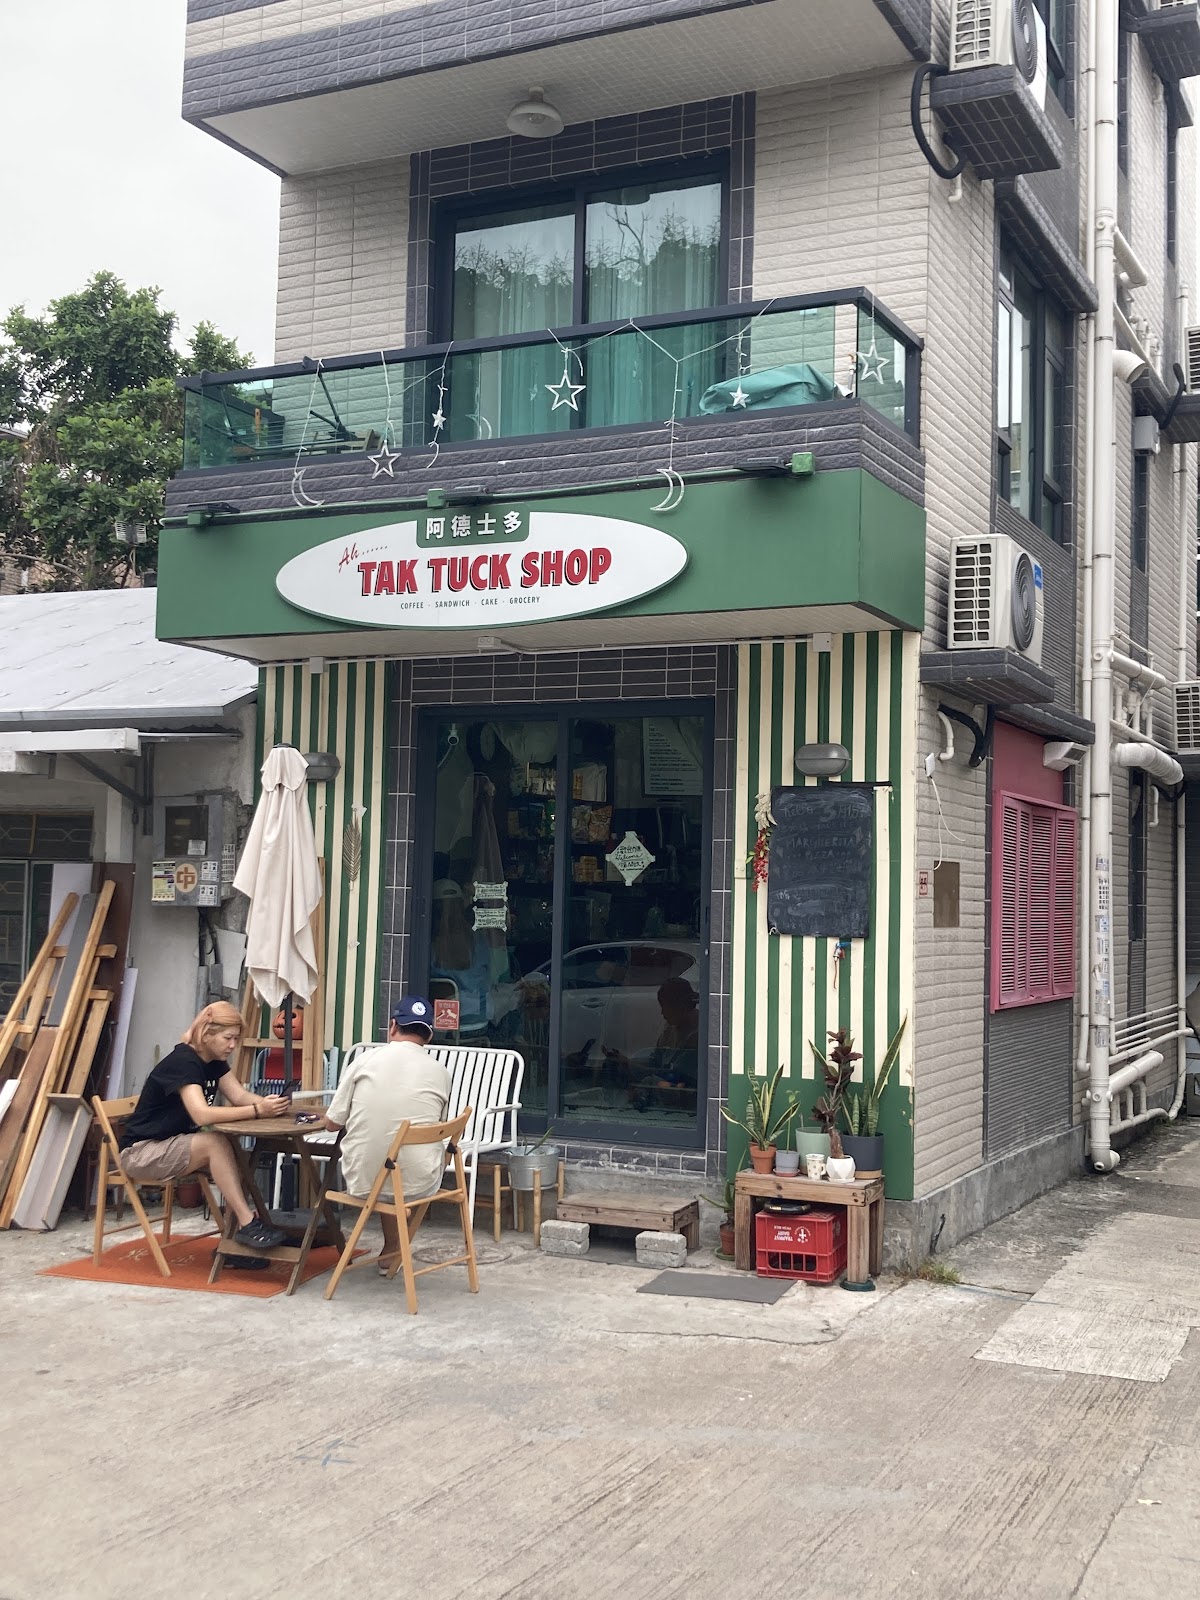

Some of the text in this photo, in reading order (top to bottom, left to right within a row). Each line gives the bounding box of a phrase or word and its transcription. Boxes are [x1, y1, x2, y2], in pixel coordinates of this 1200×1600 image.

[426, 511, 522, 540] 阿德士多
[358, 547, 612, 596] TAK TUCK SHOP
[400, 596, 540, 609] COFFEE SANDWICH CAKE GROCERY
